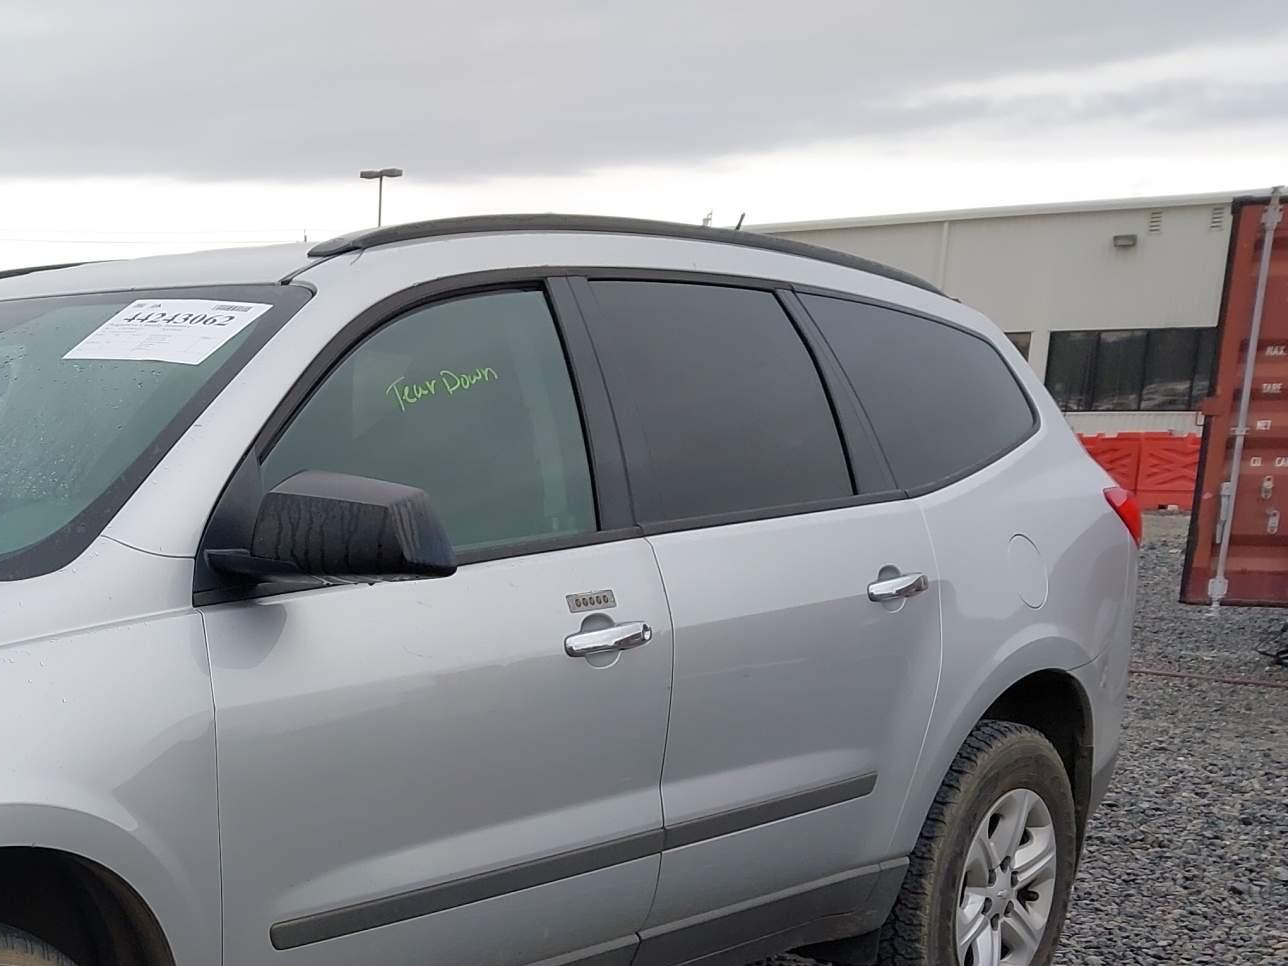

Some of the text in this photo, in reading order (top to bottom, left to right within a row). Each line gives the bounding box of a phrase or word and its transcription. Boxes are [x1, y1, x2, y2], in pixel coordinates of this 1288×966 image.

[123, 312, 235, 326] 44243062
[439, 367, 498, 395] Down
[1255, 420, 1272, 430] NET
